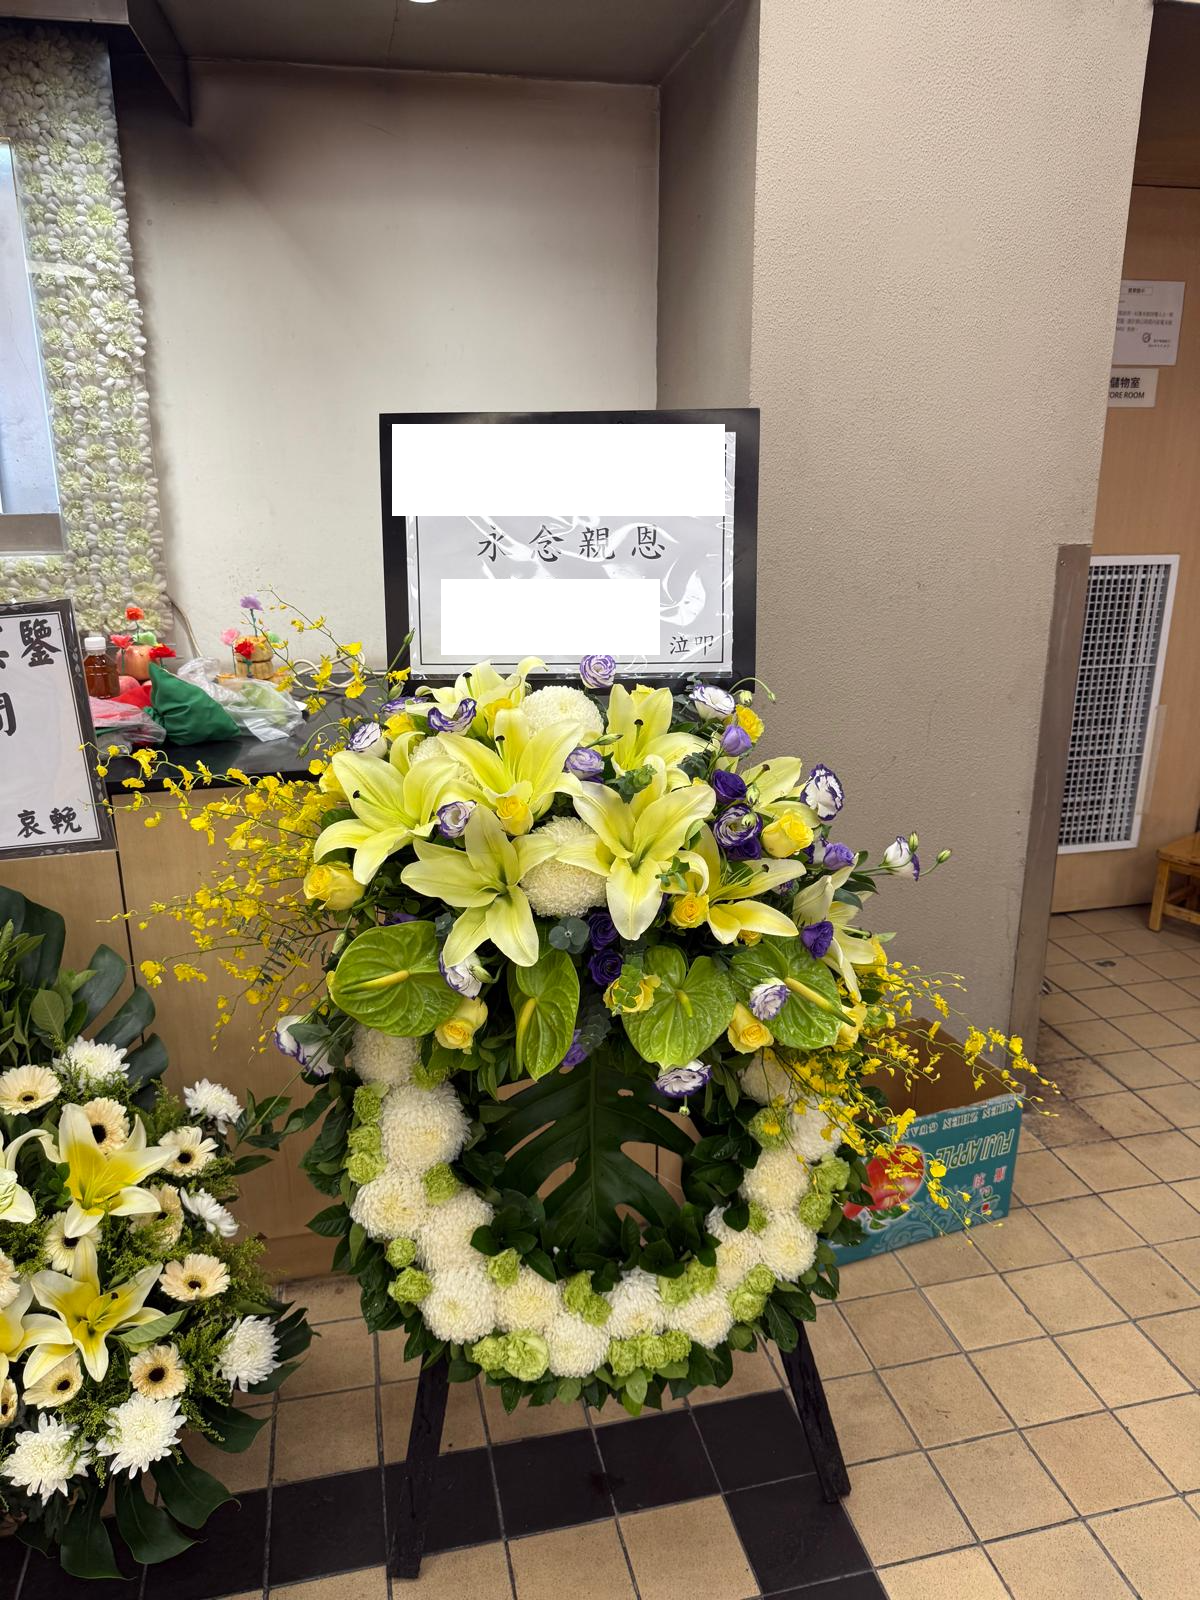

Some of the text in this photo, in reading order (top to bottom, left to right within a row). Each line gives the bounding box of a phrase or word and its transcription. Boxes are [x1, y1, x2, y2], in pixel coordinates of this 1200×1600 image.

[1108, 391, 1145, 399] ORE ROOM
[477, 524, 666, 563] 永念親恩
[0, 618, 62, 669] 鑒
[670, 635, 714, 656] 泣叩
[16, 806, 83, 839] 哀輓
[979, 1128, 1015, 1161] FUJI
